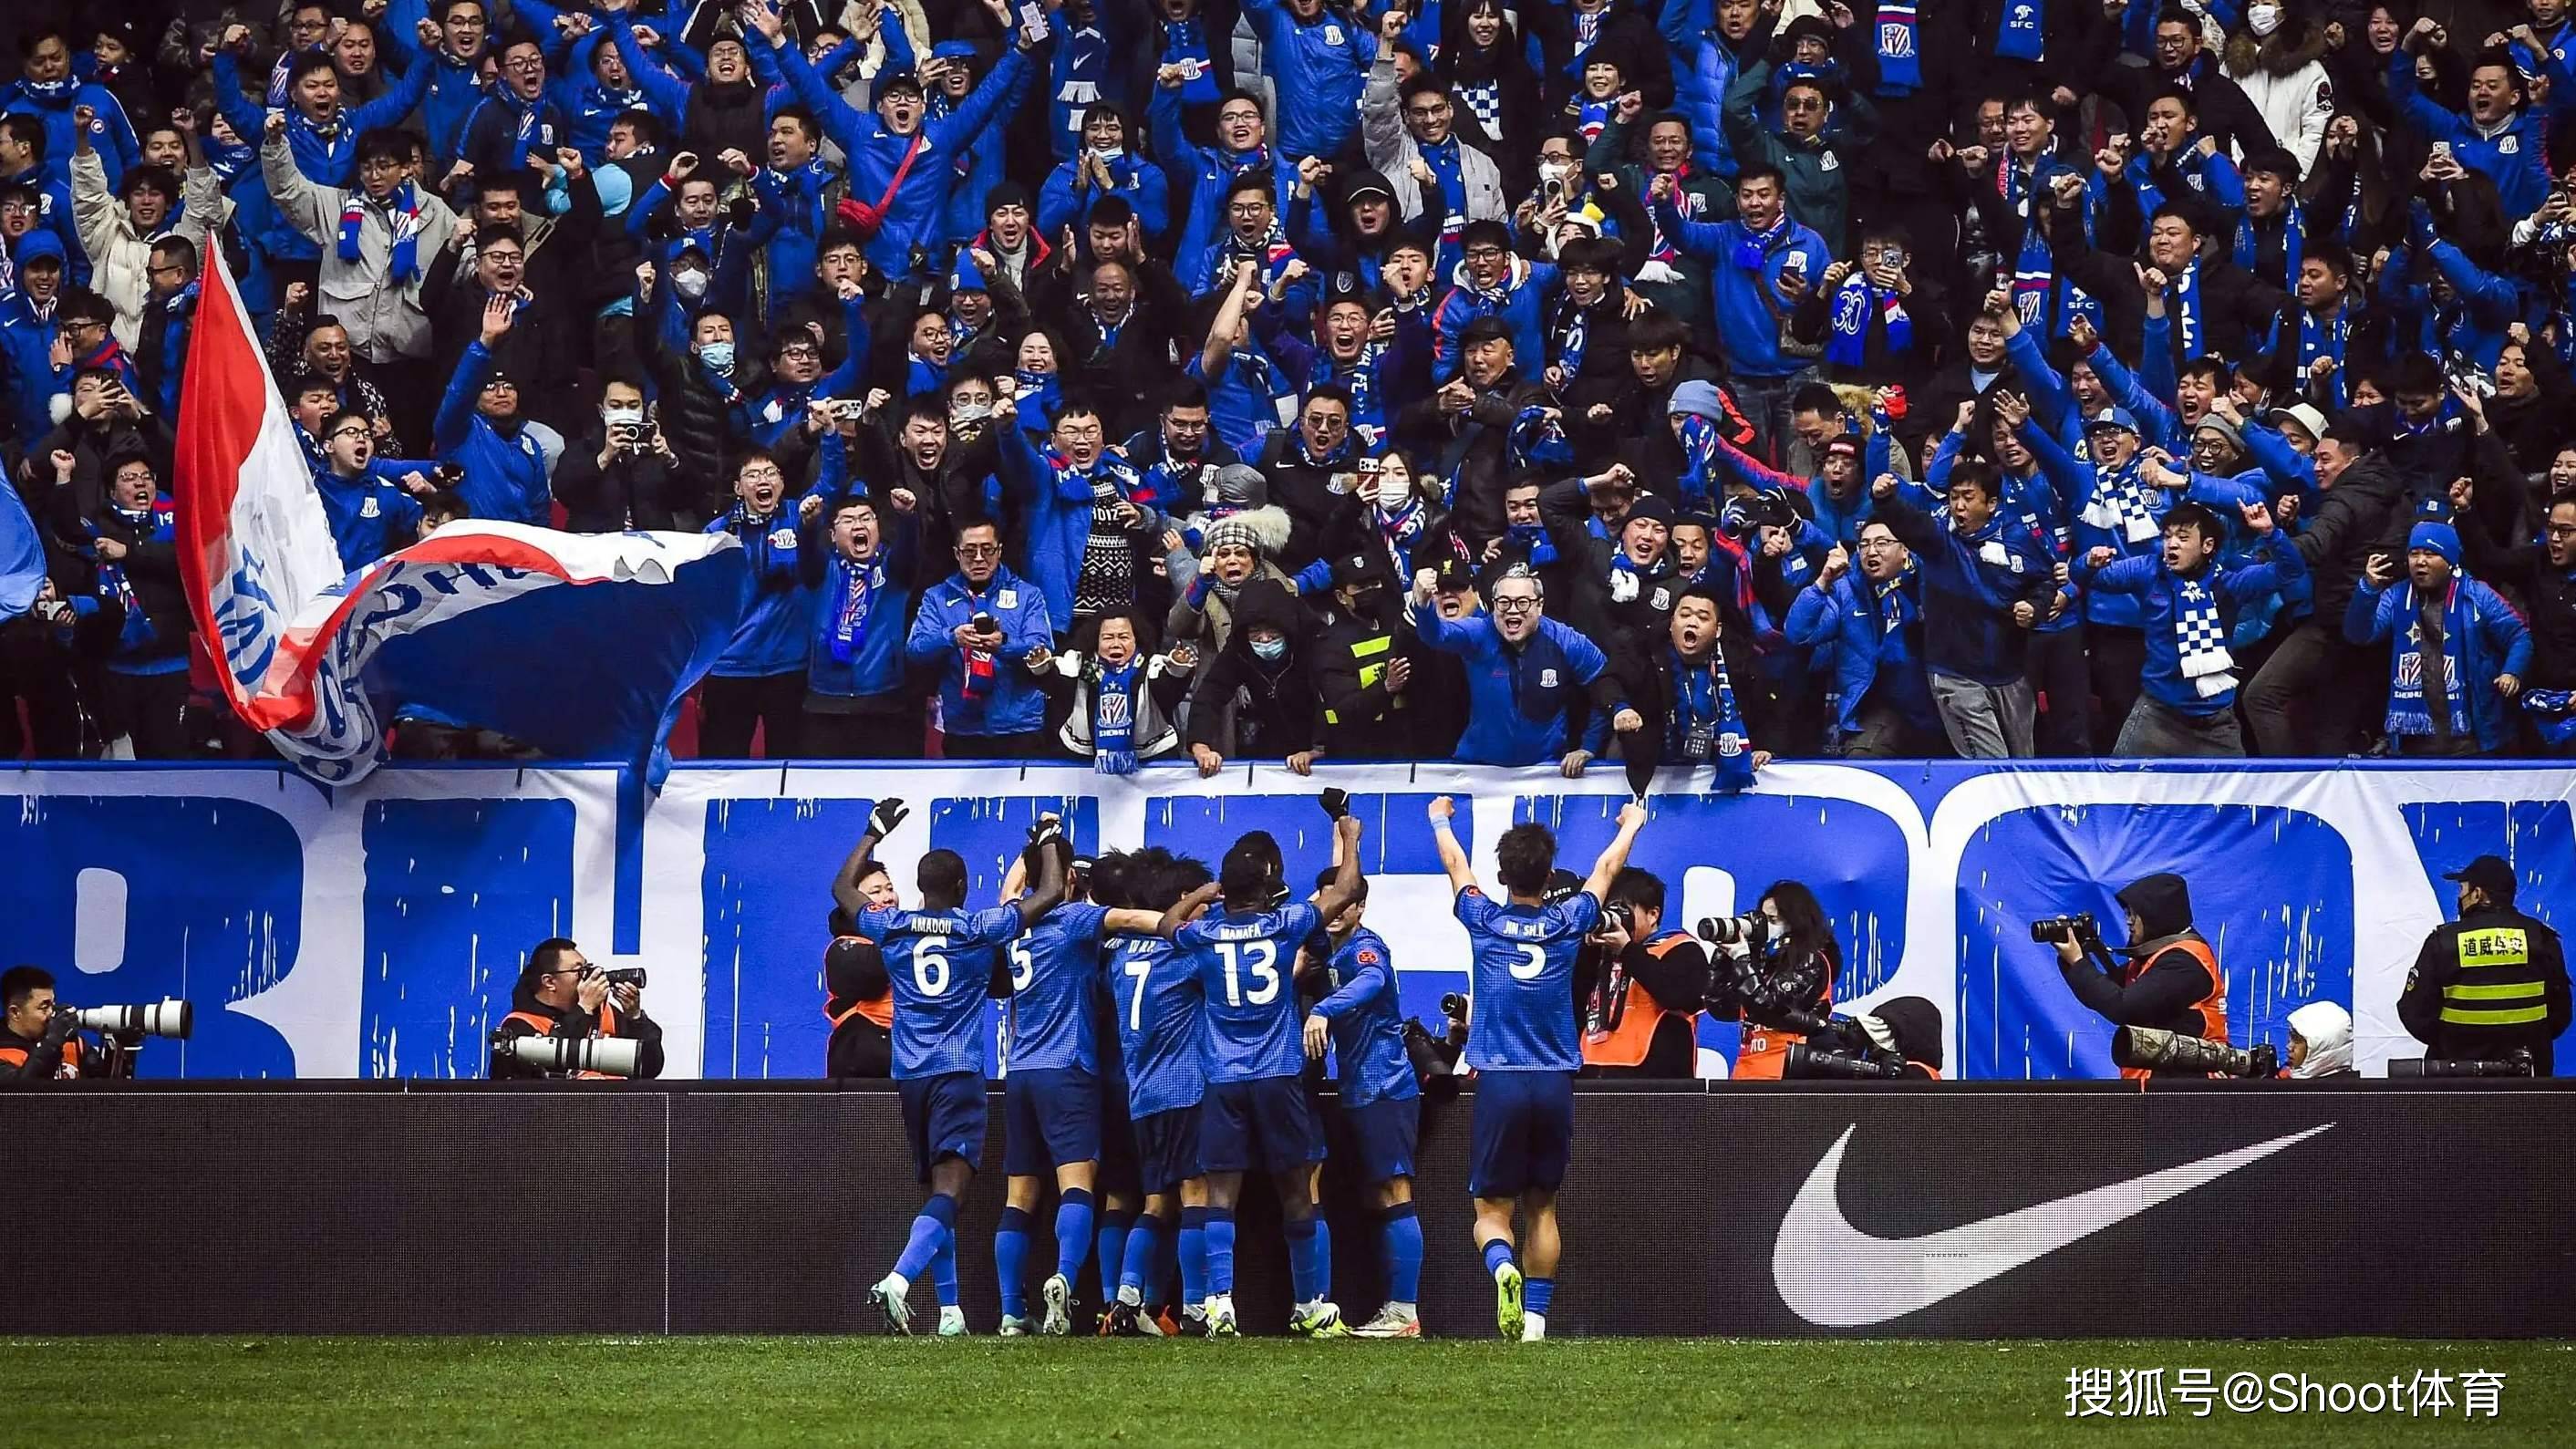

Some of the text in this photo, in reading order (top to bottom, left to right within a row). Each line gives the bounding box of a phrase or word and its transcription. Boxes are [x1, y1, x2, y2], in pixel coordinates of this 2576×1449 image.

[2009, 20, 2034, 29] SFC
[2067, 301, 2095, 310] SFC
[911, 917, 952, 934] AMADOU
[1503, 921, 1518, 935] JIN
[2463, 936, 2524, 957] 道威保安
[913, 936, 950, 997] 6
[1214, 939, 1280, 1007] 13
[1123, 961, 1152, 1030] 7
